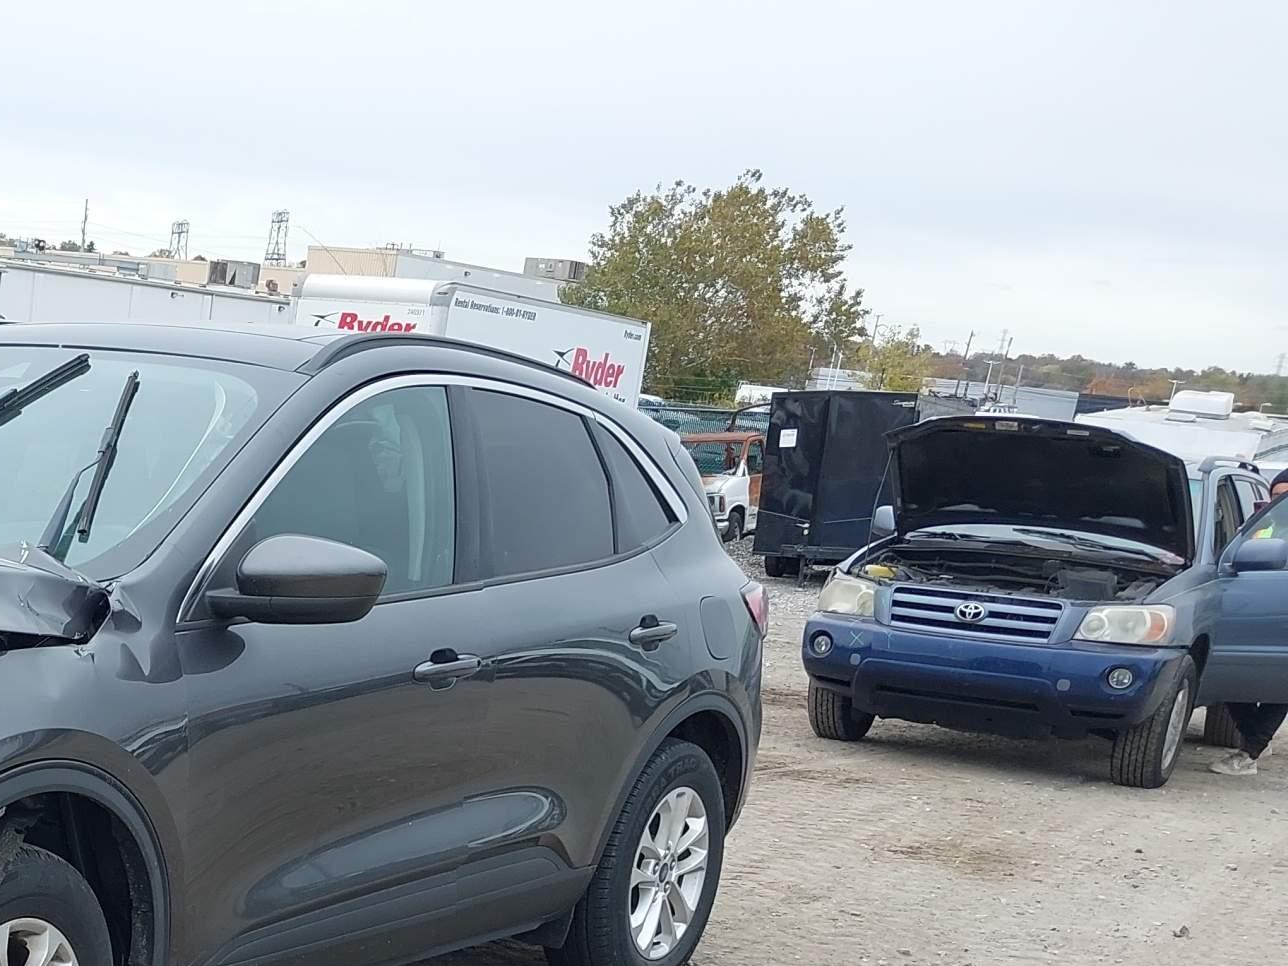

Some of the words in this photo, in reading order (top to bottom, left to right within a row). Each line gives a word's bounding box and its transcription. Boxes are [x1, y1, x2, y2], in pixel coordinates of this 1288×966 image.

[454, 297, 470, 309] Rental
[338, 312, 418, 333] Ryder
[572, 347, 625, 388] Ryder
